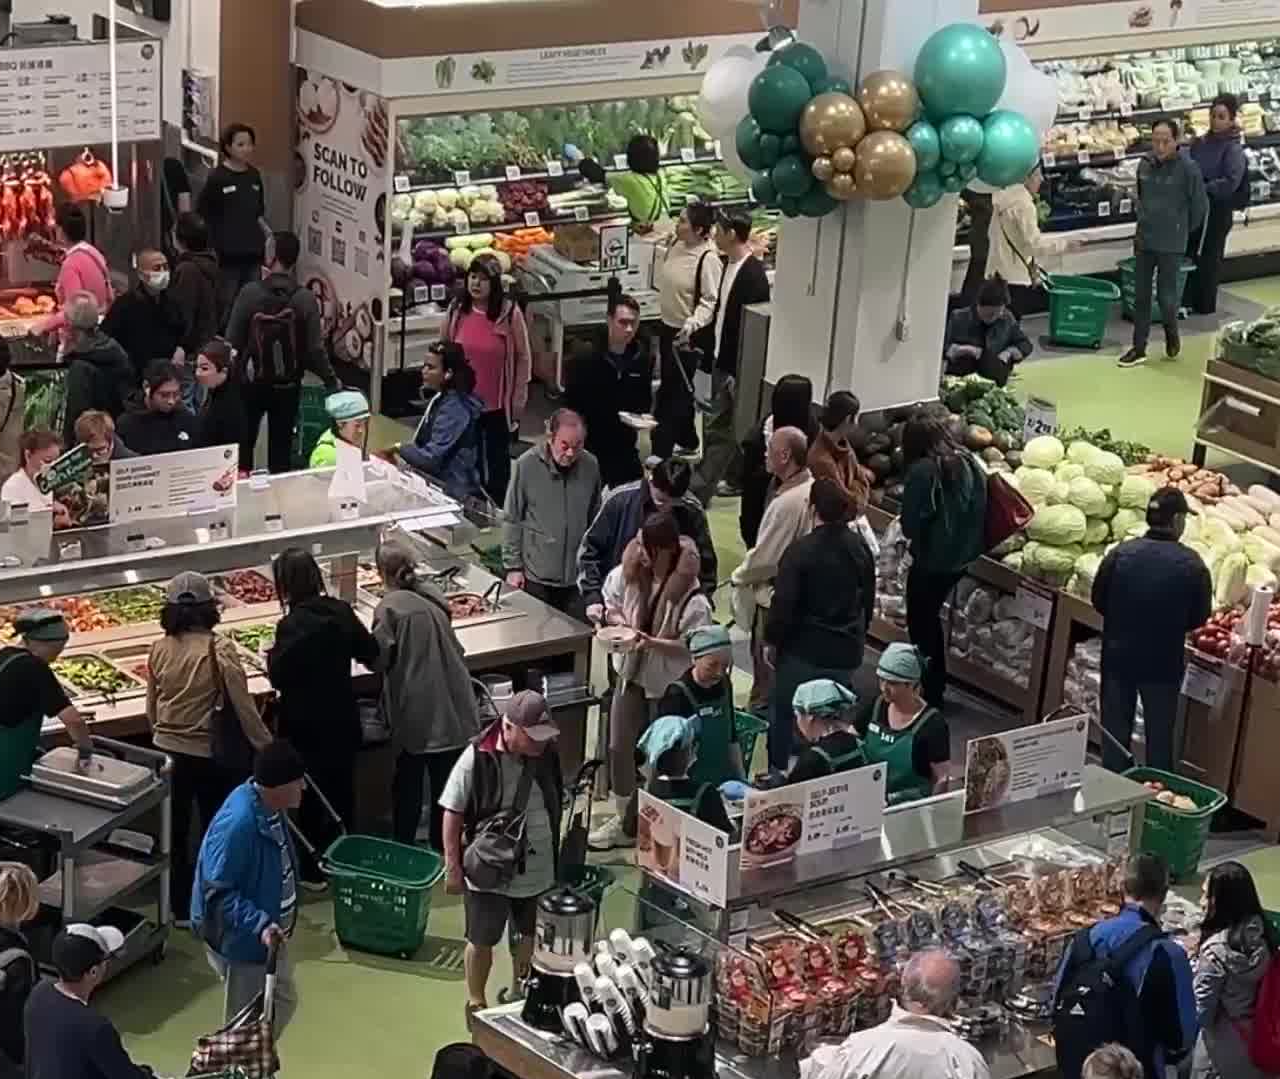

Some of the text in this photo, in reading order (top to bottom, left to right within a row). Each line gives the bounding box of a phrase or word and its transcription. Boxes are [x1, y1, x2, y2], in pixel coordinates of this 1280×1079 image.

[313, 142, 368, 179] SCAN TO
[313, 164, 367, 202] FOLLOW
